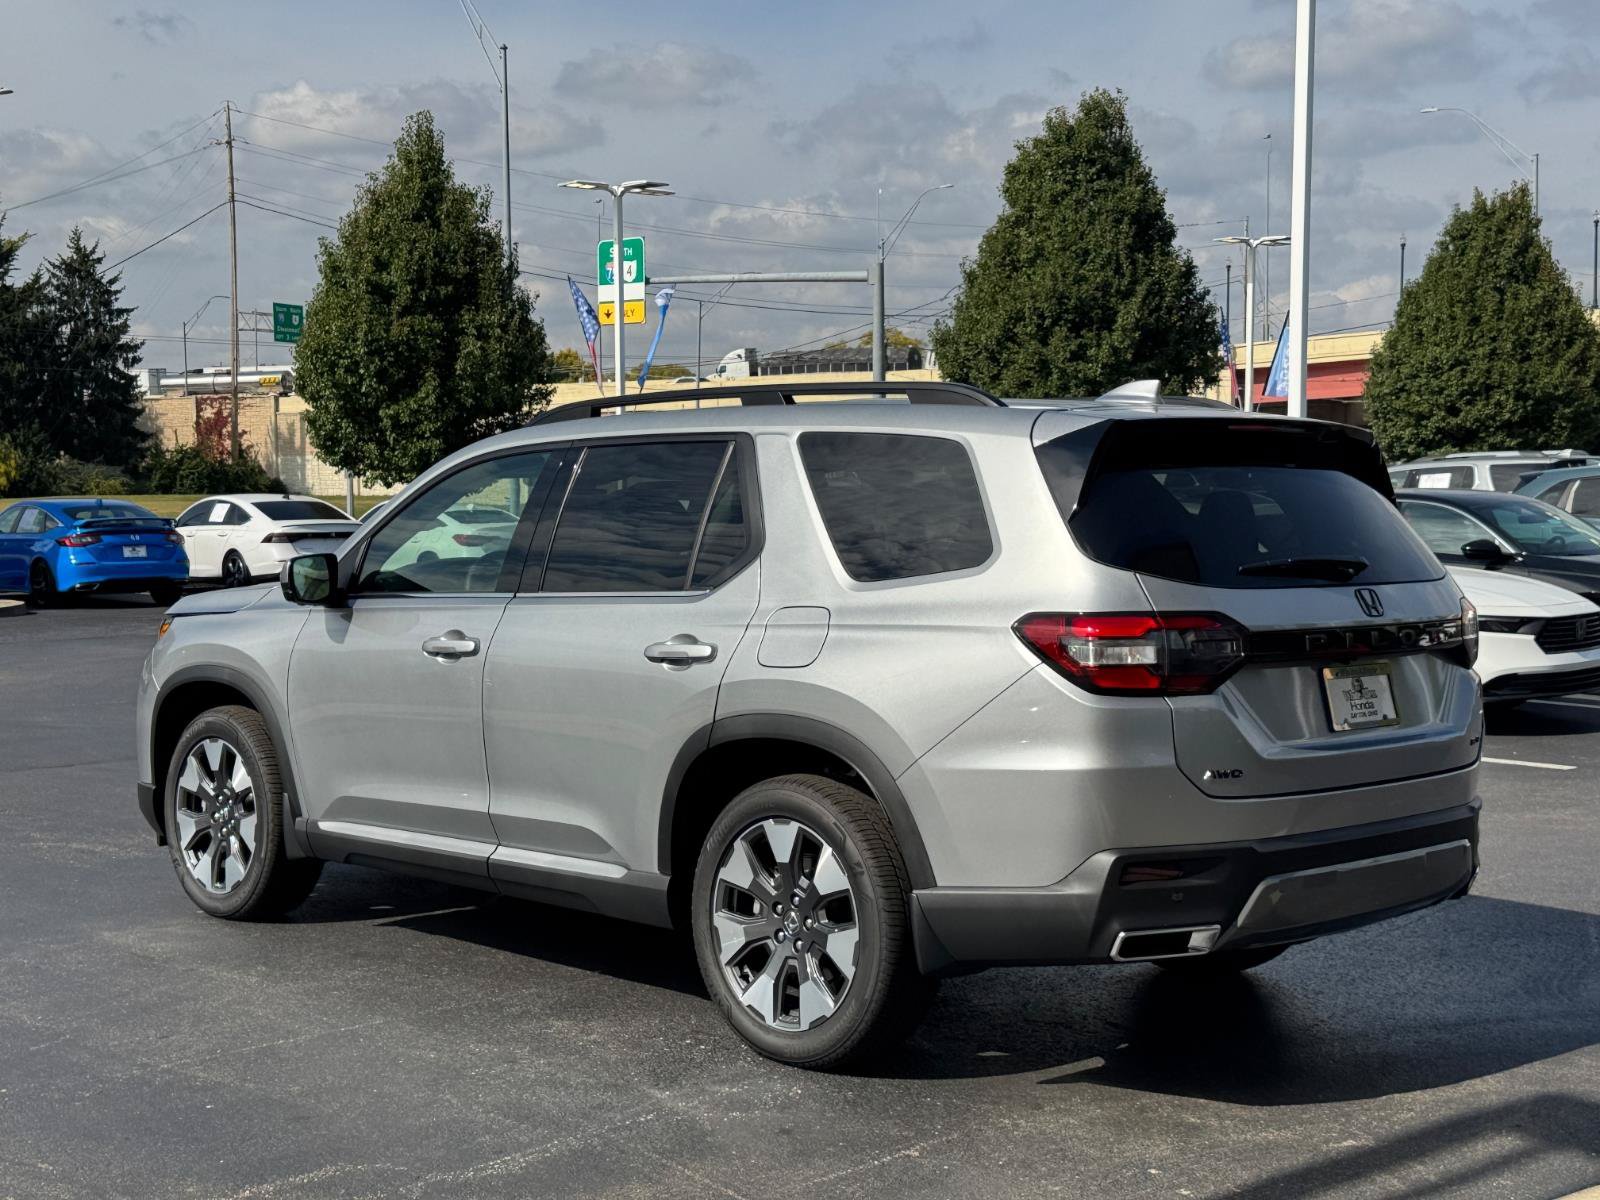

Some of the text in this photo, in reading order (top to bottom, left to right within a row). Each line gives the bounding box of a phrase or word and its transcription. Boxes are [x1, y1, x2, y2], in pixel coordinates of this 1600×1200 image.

[609, 247, 633, 258] STH
[1350, 701, 1375, 711] Honda
[1203, 766, 1244, 780] AWD
